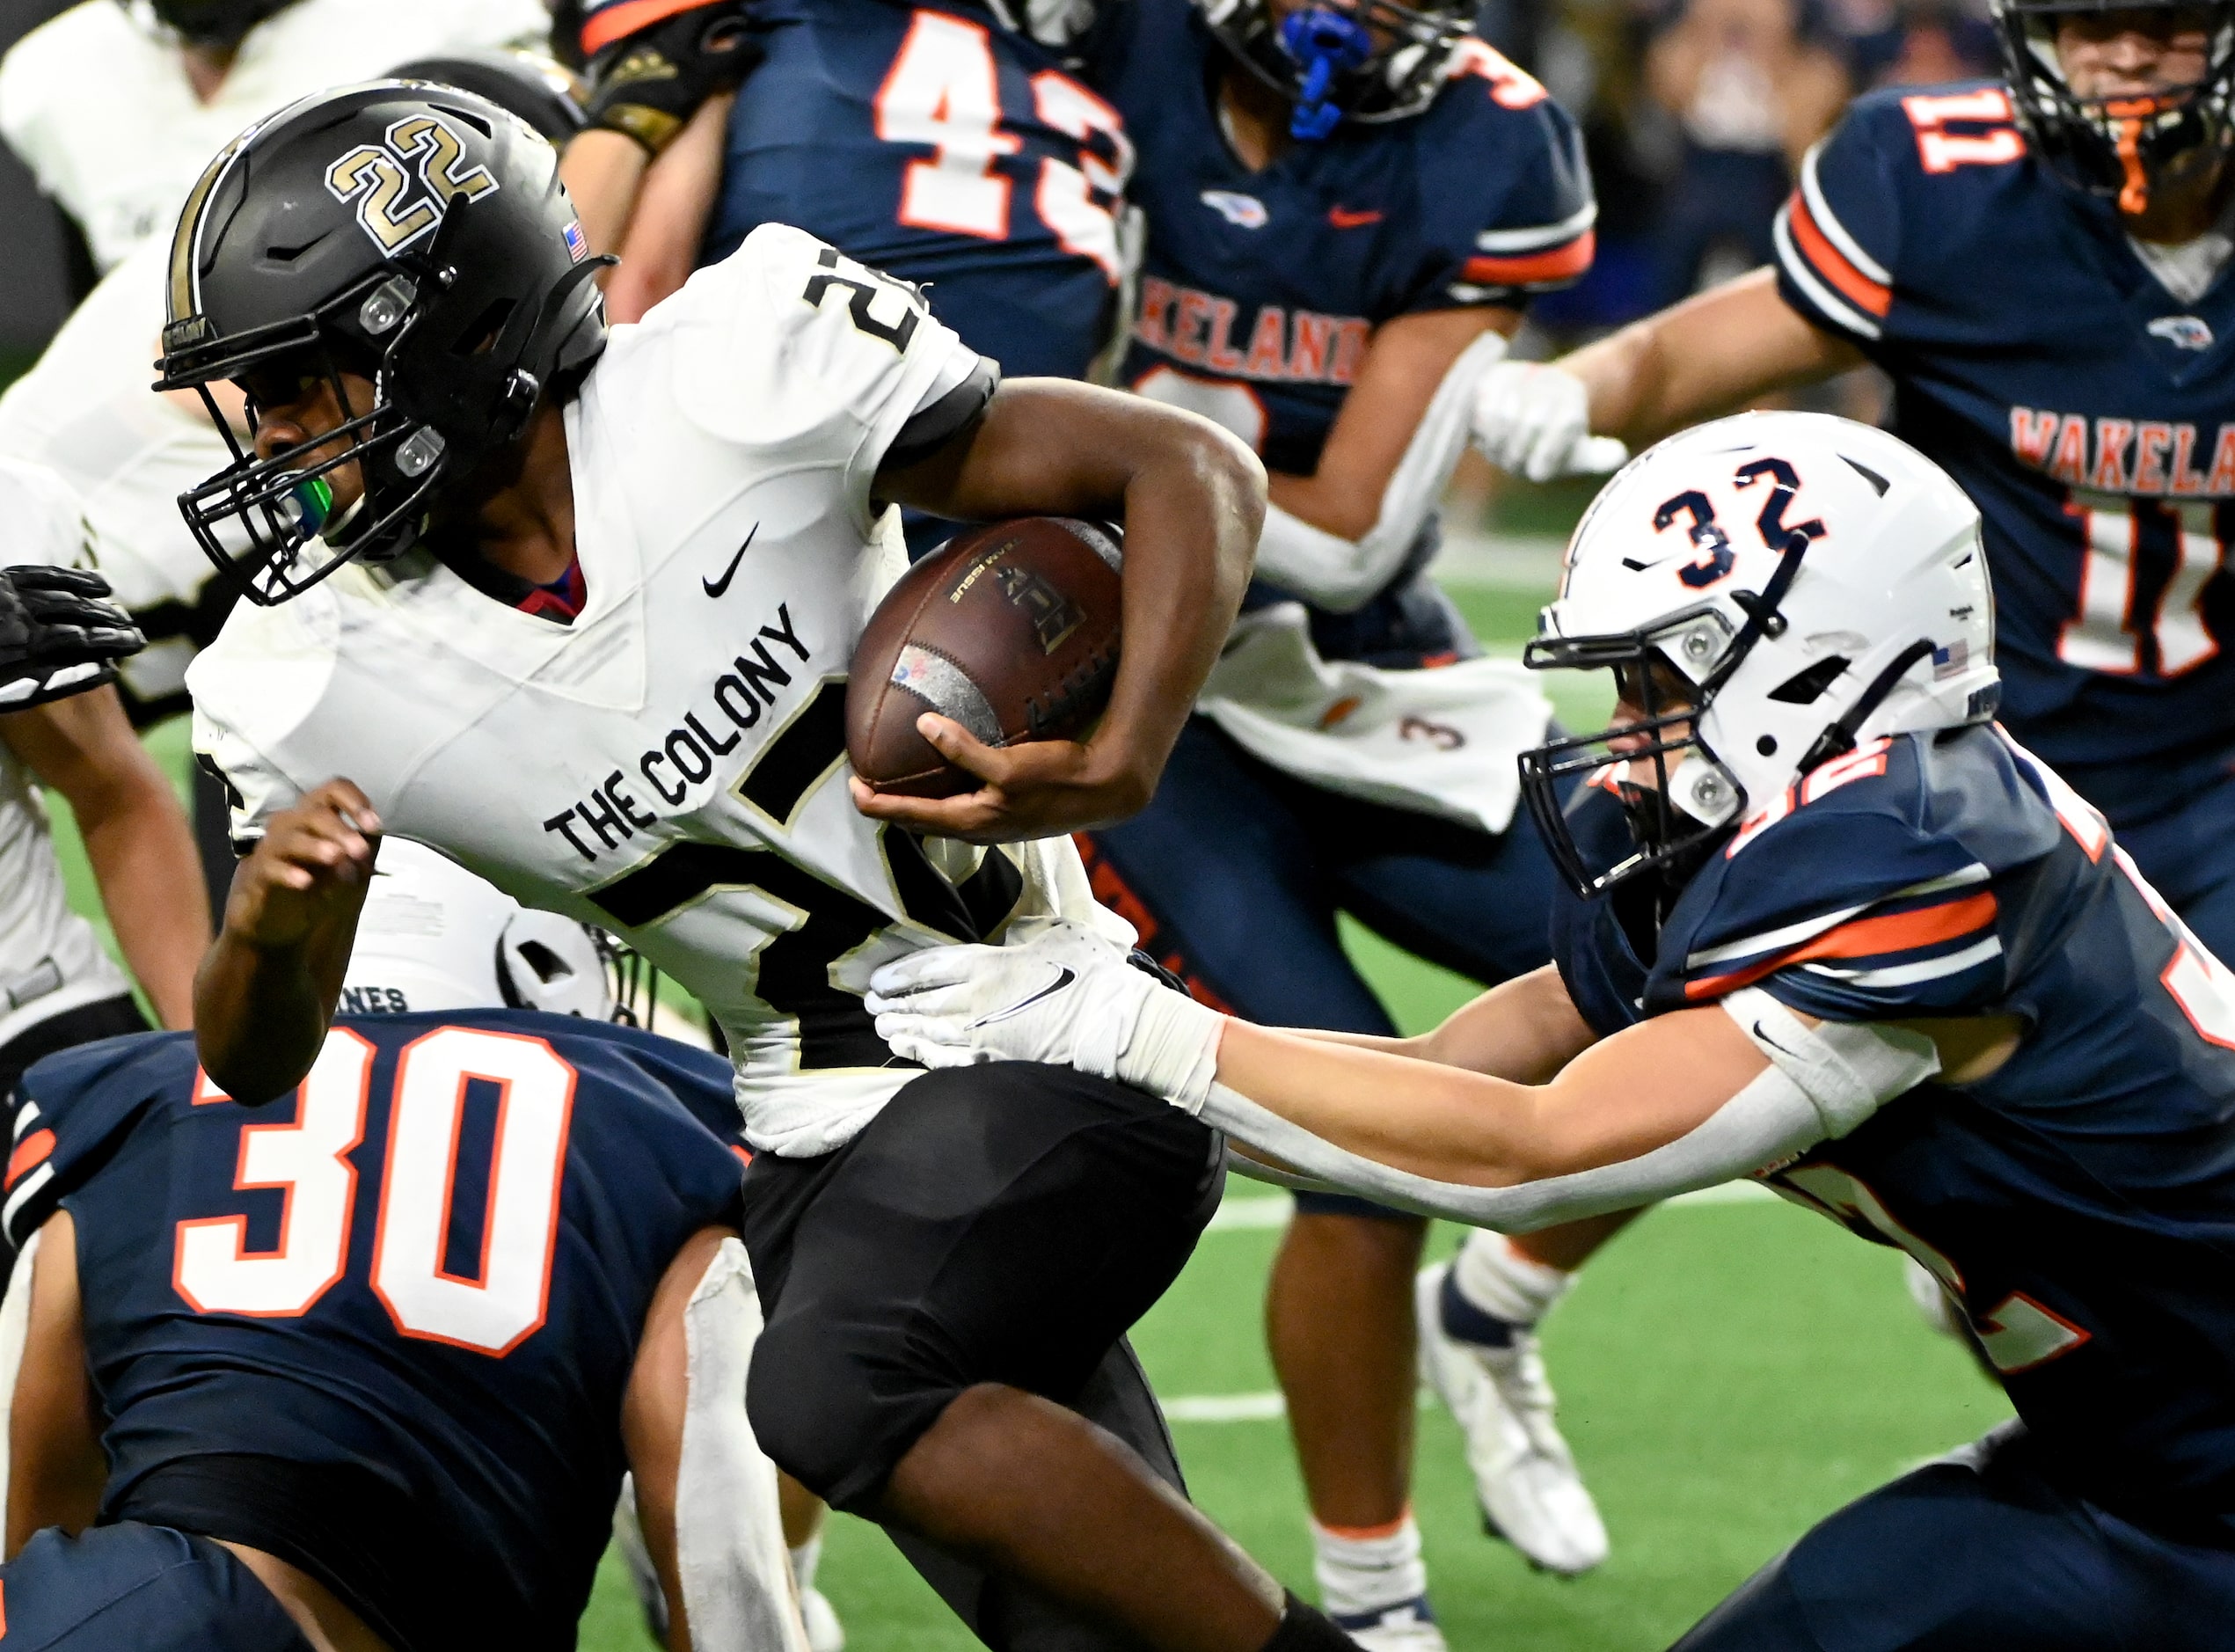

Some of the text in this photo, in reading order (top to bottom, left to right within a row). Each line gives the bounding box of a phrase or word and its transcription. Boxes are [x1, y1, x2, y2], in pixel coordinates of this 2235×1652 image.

[324, 113, 500, 259] 22
[1900, 87, 2027, 174] 11
[2009, 404, 2235, 498] WAKELA
[1652, 456, 1829, 590] 32
[949, 563, 986, 604] ISSUE
[543, 602, 810, 863] THE COLONY
[335, 986, 408, 1016] NES
[172, 1025, 578, 1359] 30
